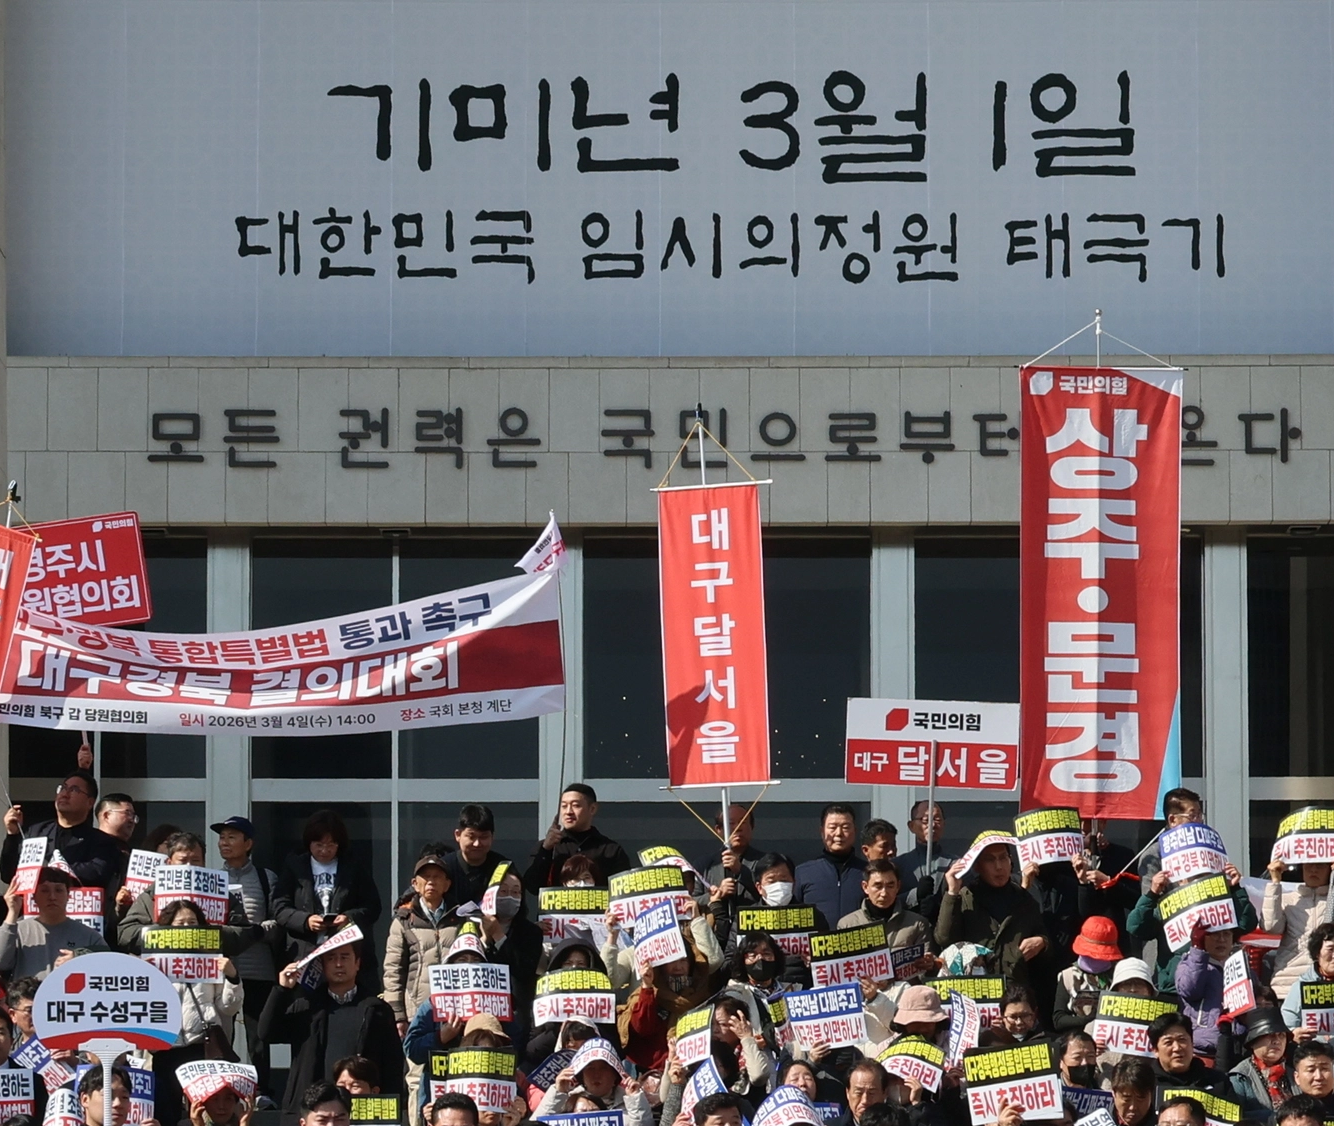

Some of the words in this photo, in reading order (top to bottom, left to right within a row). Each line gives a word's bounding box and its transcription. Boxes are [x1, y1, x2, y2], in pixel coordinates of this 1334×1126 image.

[328, 75, 680, 172] 기미년
[740, 70, 928, 183] 3월
[992, 70, 1137, 179] 1일
[235, 209, 537, 284] 대한민국
[581, 211, 961, 285] 임시의정원
[1006, 209, 1227, 281] 태극기
[1059, 376, 1128, 396] 국민의힘
[147, 408, 280, 469] 모든
[338, 404, 542, 471] 권력은
[104, 519, 134, 529] 국민의힘
[22, 574, 141, 619] 원협의회
[147, 628, 330, 667] 통합특별법
[338, 610, 413, 651] 통과
[420, 592, 493, 633] 촉구
[17, 641, 232, 706] 대구경북
[250, 641, 459, 707] 결의대회
[40, 705, 64, 721] 북구
[68, 708, 81, 723] 갑
[85, 709, 148, 723] 당원협의회
[179, 713, 205, 726] 일시
[208, 715, 257, 728] 2026년
[261, 715, 283, 728] 3월
[287, 714, 332, 728] 4일(수)
[336, 713, 375, 726] 14:00
[400, 708, 426, 721] 장소
[429, 705, 454, 718] 국회
[458, 702, 483, 715] 본청
[486, 699, 512, 712] 계단
[914, 712, 981, 731] 국민의힘
[854, 752, 889, 772] 대구
[87, 974, 150, 993] 국민의힘
[536, 973, 611, 992] 대구경북행정통합특별법
[46, 1000, 87, 1024] 대구
[91, 999, 169, 1024] 수성구을
[534, 997, 558, 1022] 즉시
[563, 995, 615, 1021] 추진하라
[965, 1046, 1051, 1082] 대구경북행정통합특별법
